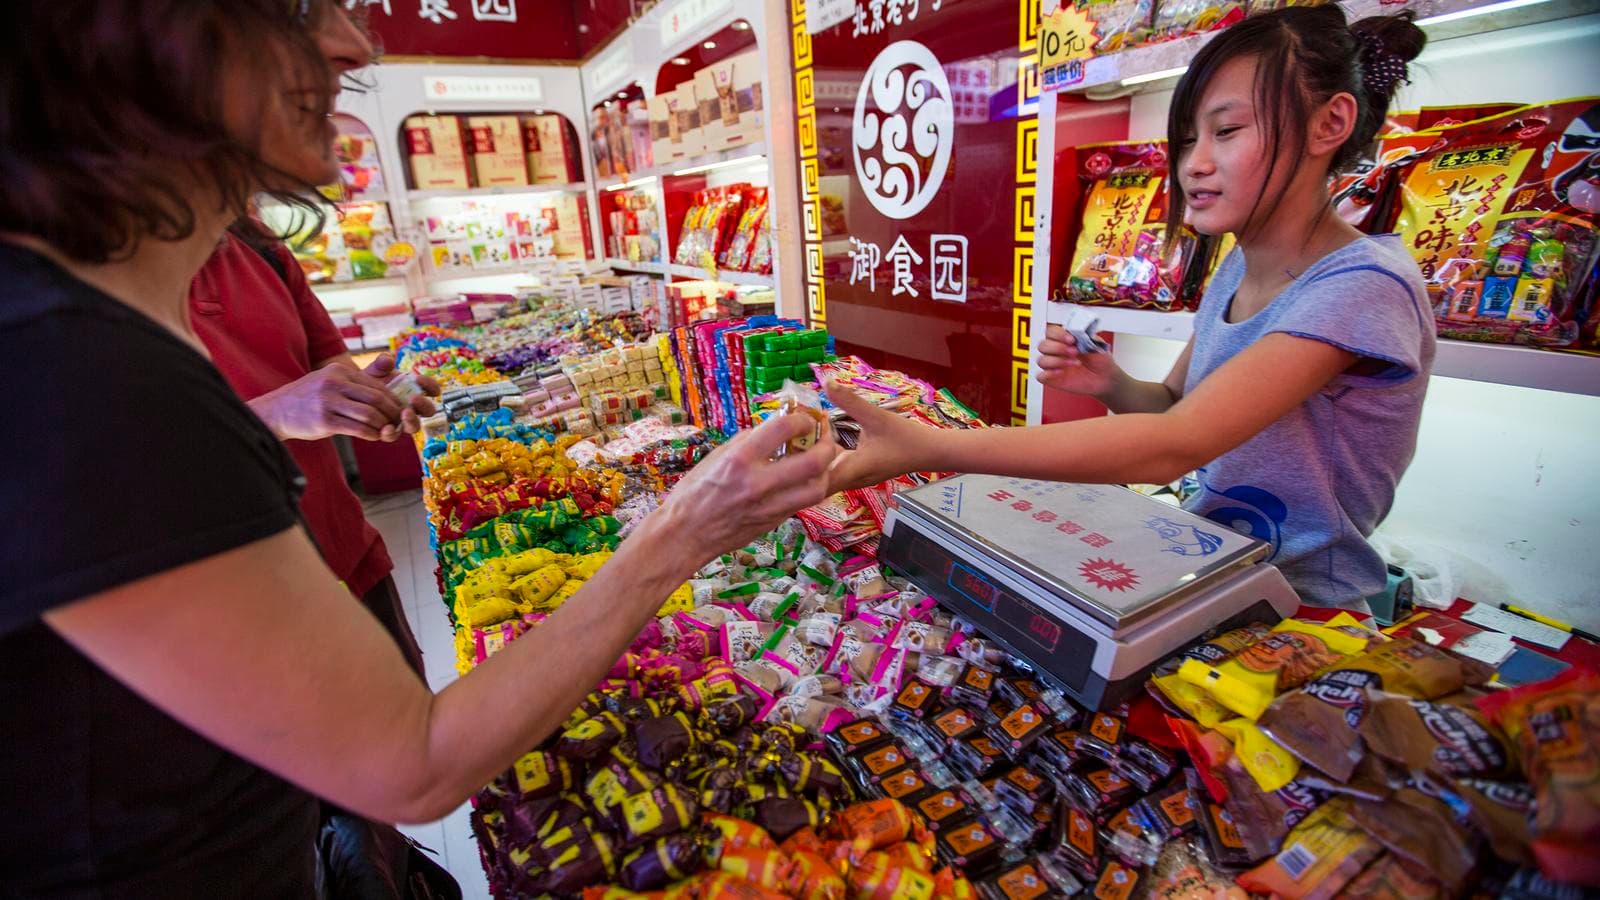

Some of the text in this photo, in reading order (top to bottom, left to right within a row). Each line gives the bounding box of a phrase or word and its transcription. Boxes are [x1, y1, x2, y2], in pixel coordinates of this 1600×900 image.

[852, 0, 942, 38] 北京老
[1040, 29, 1085, 67] 10元
[1441, 148, 1504, 166] 老北京
[848, 233, 969, 304] 御食园
